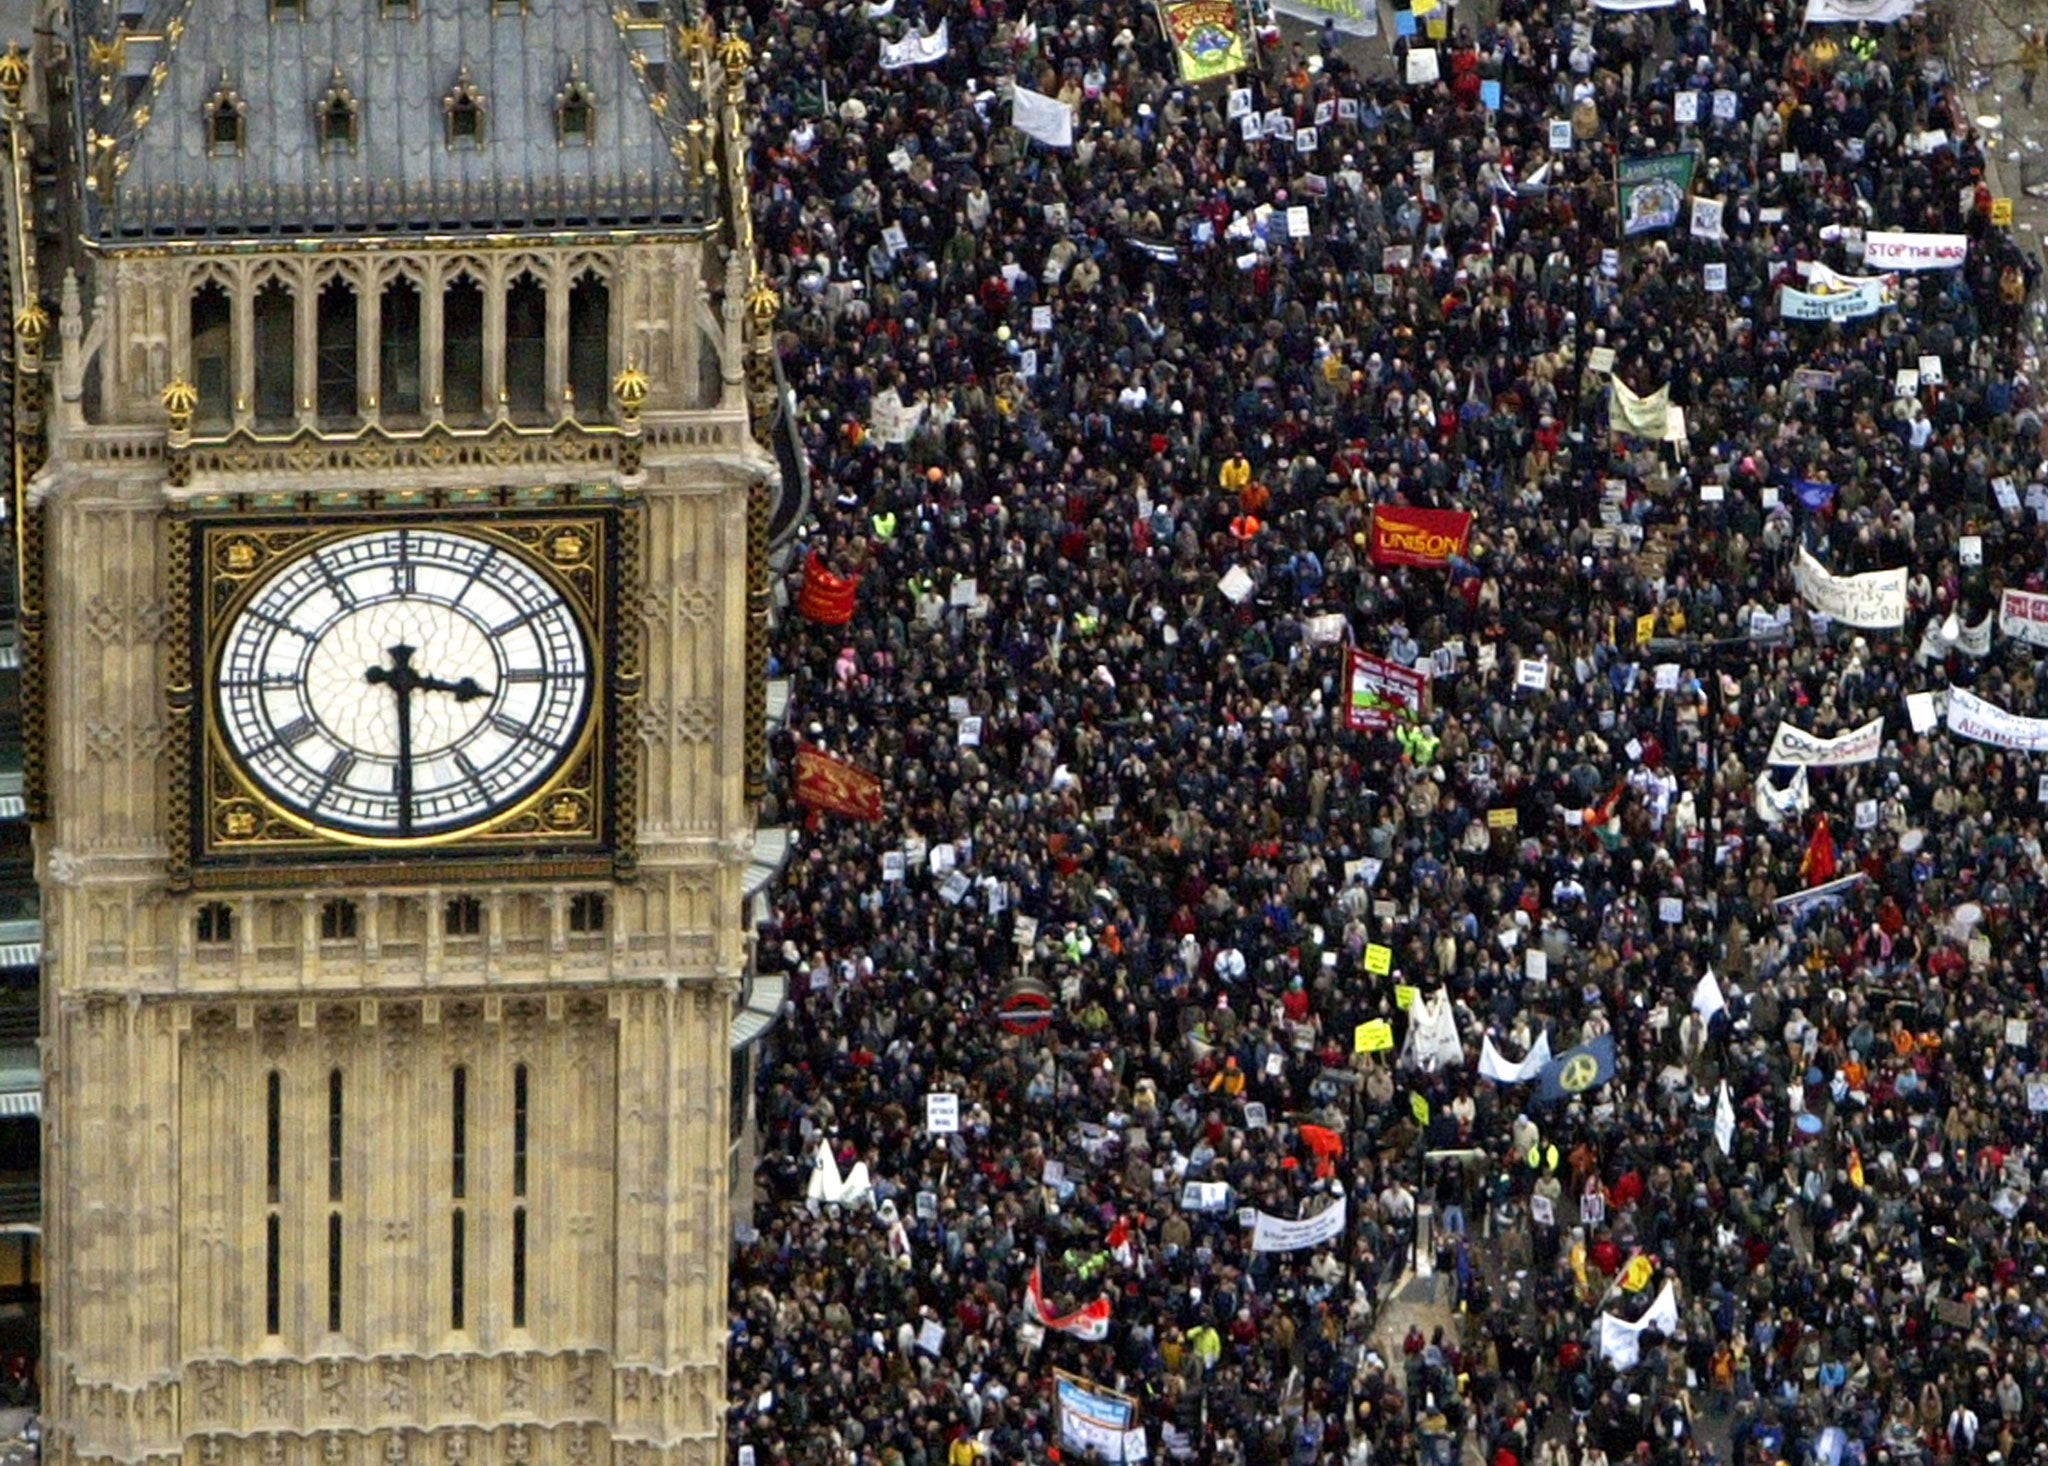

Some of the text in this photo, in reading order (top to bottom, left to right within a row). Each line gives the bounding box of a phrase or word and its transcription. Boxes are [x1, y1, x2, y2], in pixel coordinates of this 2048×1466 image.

[1868, 243, 1965, 259] STOP THE WAR
[1380, 532, 1459, 557] UNISON
[1957, 717, 2040, 749] AGAINST
